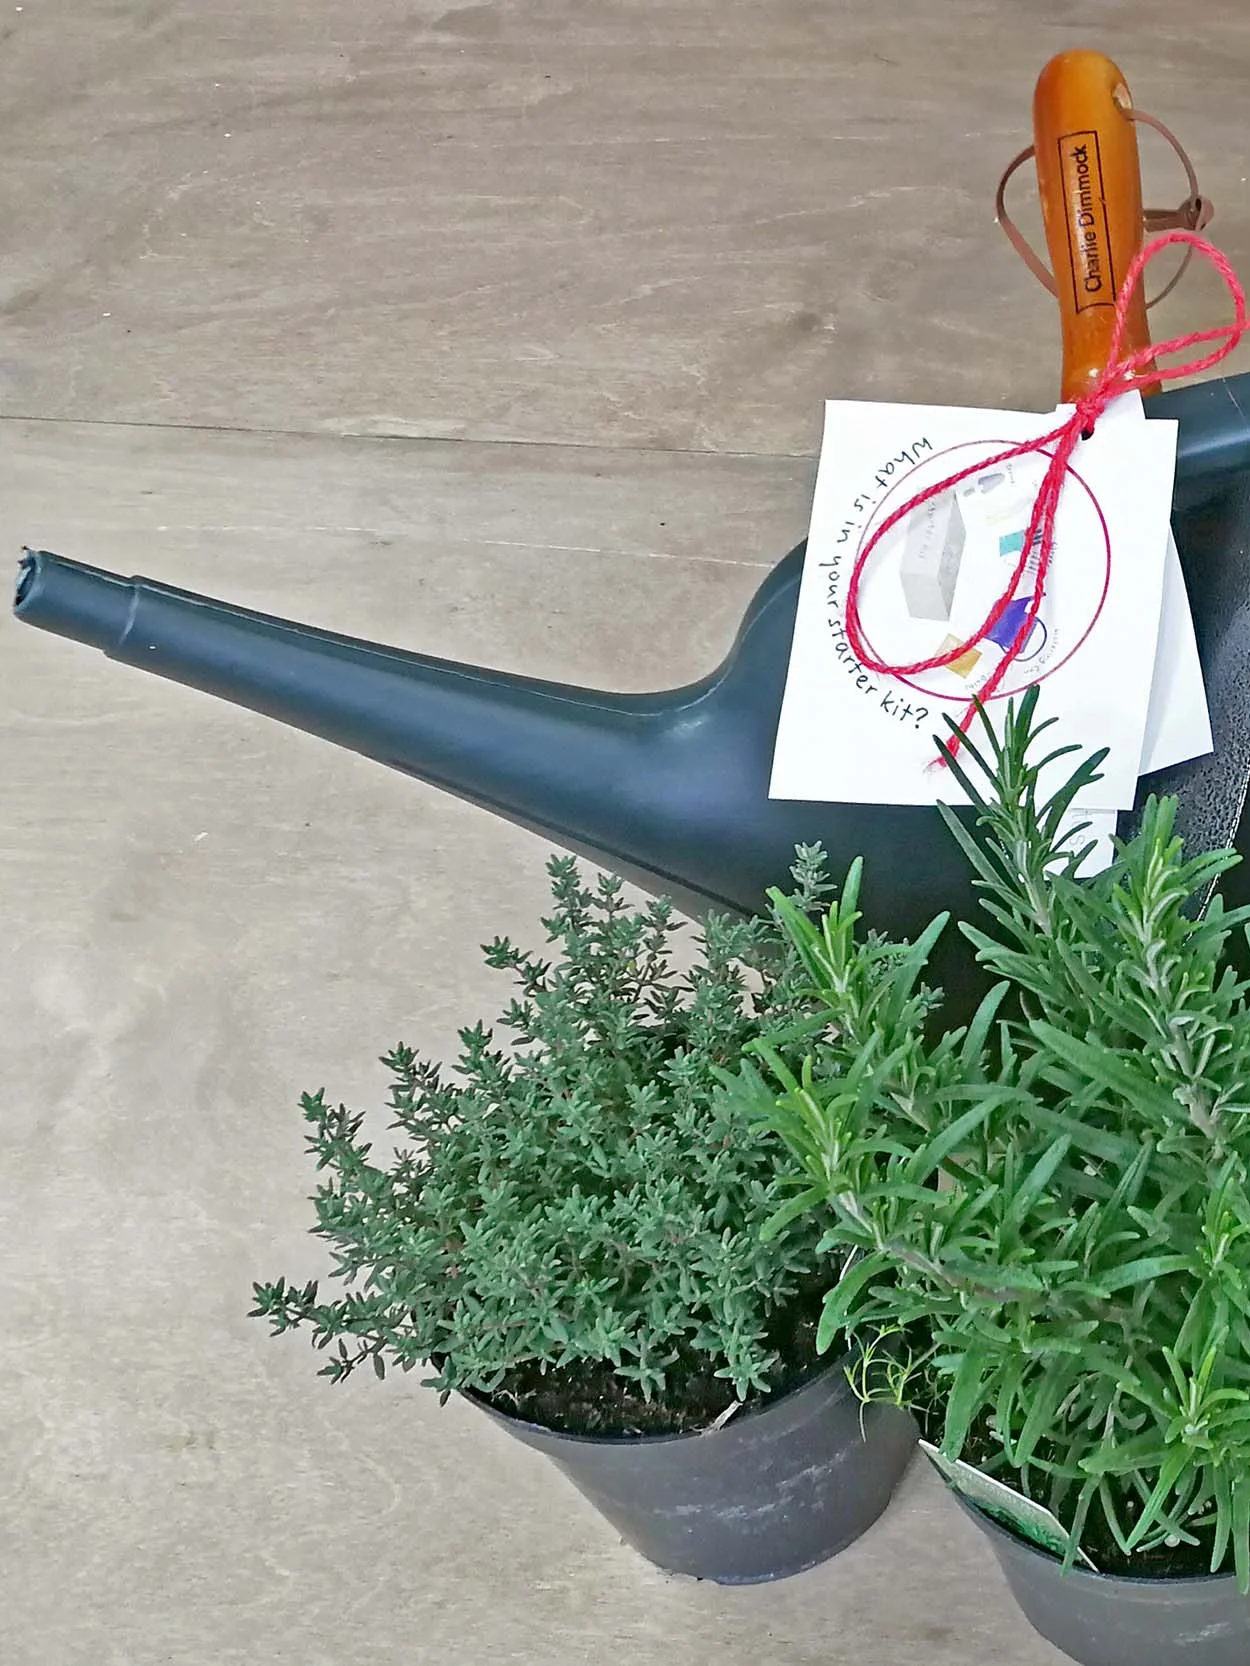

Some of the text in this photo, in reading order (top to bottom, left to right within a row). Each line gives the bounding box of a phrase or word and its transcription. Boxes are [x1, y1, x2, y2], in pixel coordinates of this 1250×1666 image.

[1071, 144, 1101, 292] Charlie Dimmock
[875, 437, 933, 488] What
[854, 494, 876, 512] is
[837, 521, 862, 543] in
[818, 555, 842, 608] your
[828, 619, 878, 694] starter
[880, 690, 929, 729] kit?
